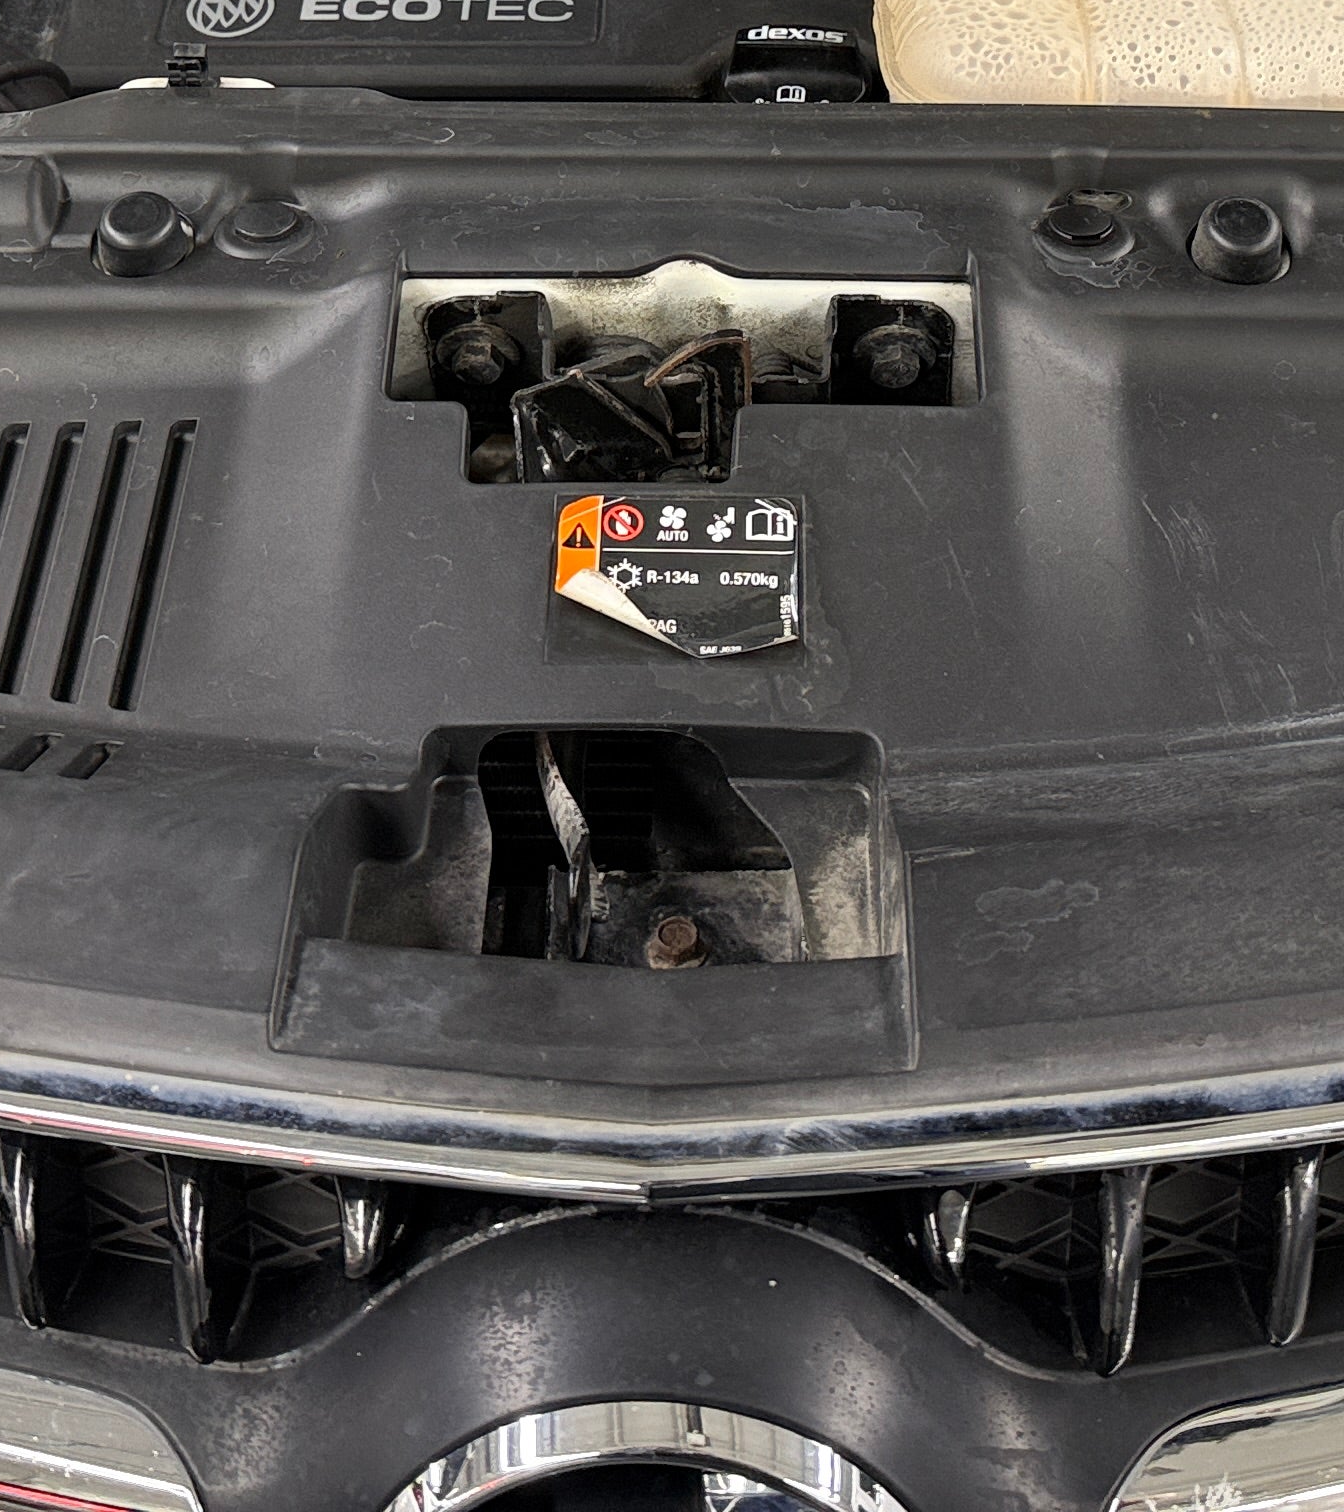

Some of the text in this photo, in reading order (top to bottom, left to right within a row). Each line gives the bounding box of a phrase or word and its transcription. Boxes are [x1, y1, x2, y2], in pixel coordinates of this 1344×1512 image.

[747, 24, 845, 43] dexos
[656, 530, 689, 543] AUTO
[646, 571, 779, 589] R-134a 0.570kg
